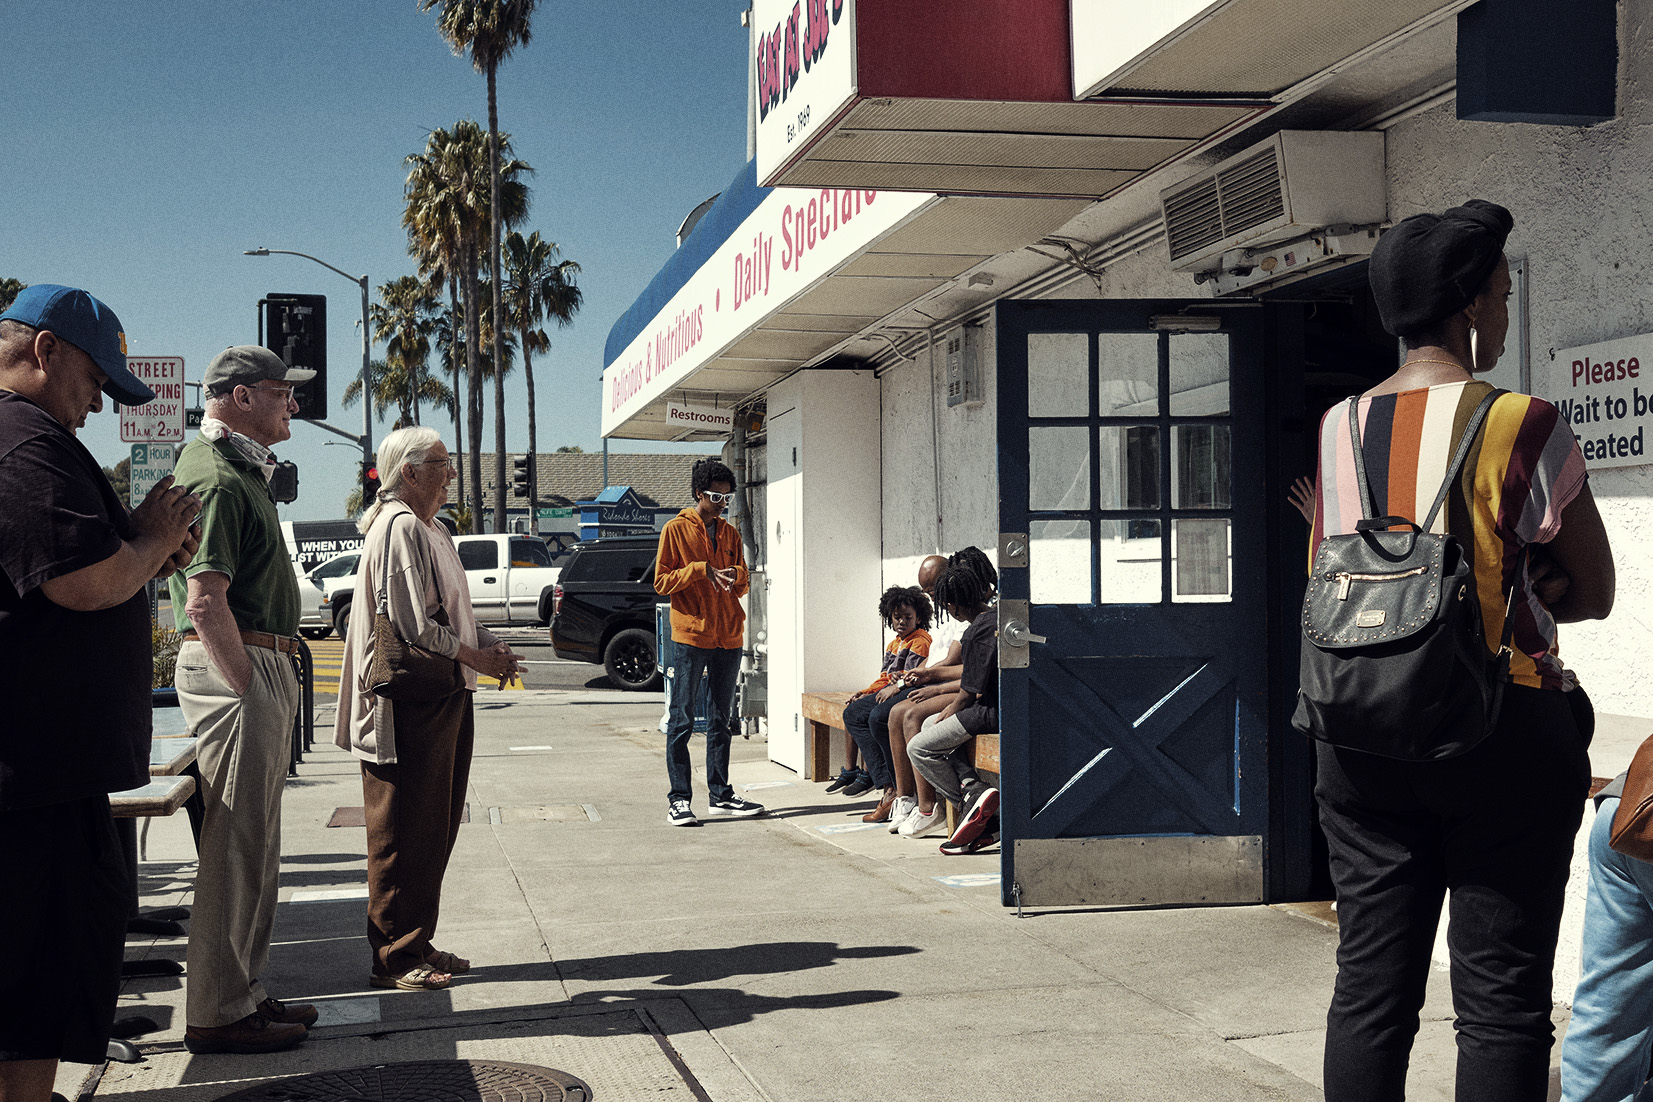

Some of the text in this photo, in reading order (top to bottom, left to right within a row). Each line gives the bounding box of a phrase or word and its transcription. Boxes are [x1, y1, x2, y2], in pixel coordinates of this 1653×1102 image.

[757, 30, 781, 124] EAT
[782, 0, 800, 104] AT
[797, 104, 810, 132] 1969
[612, 360, 642, 413] Delicious
[645, 341, 653, 384] &
[655, 303, 703, 377] Nutritious
[734, 231, 773, 311] Daily
[129, 362, 176, 378] STREET
[1572, 356, 1640, 387] Please
[126, 404, 177, 416] THURSDAY
[670, 408, 731, 425] Restrooms
[1555, 387, 1653, 424] Wait to b
[135, 448, 170, 461] 2 HOUR
[1576, 426, 1644, 461] eated
[301, 539, 364, 552] WHEN YOU
[316, 551, 342, 562] WIT
